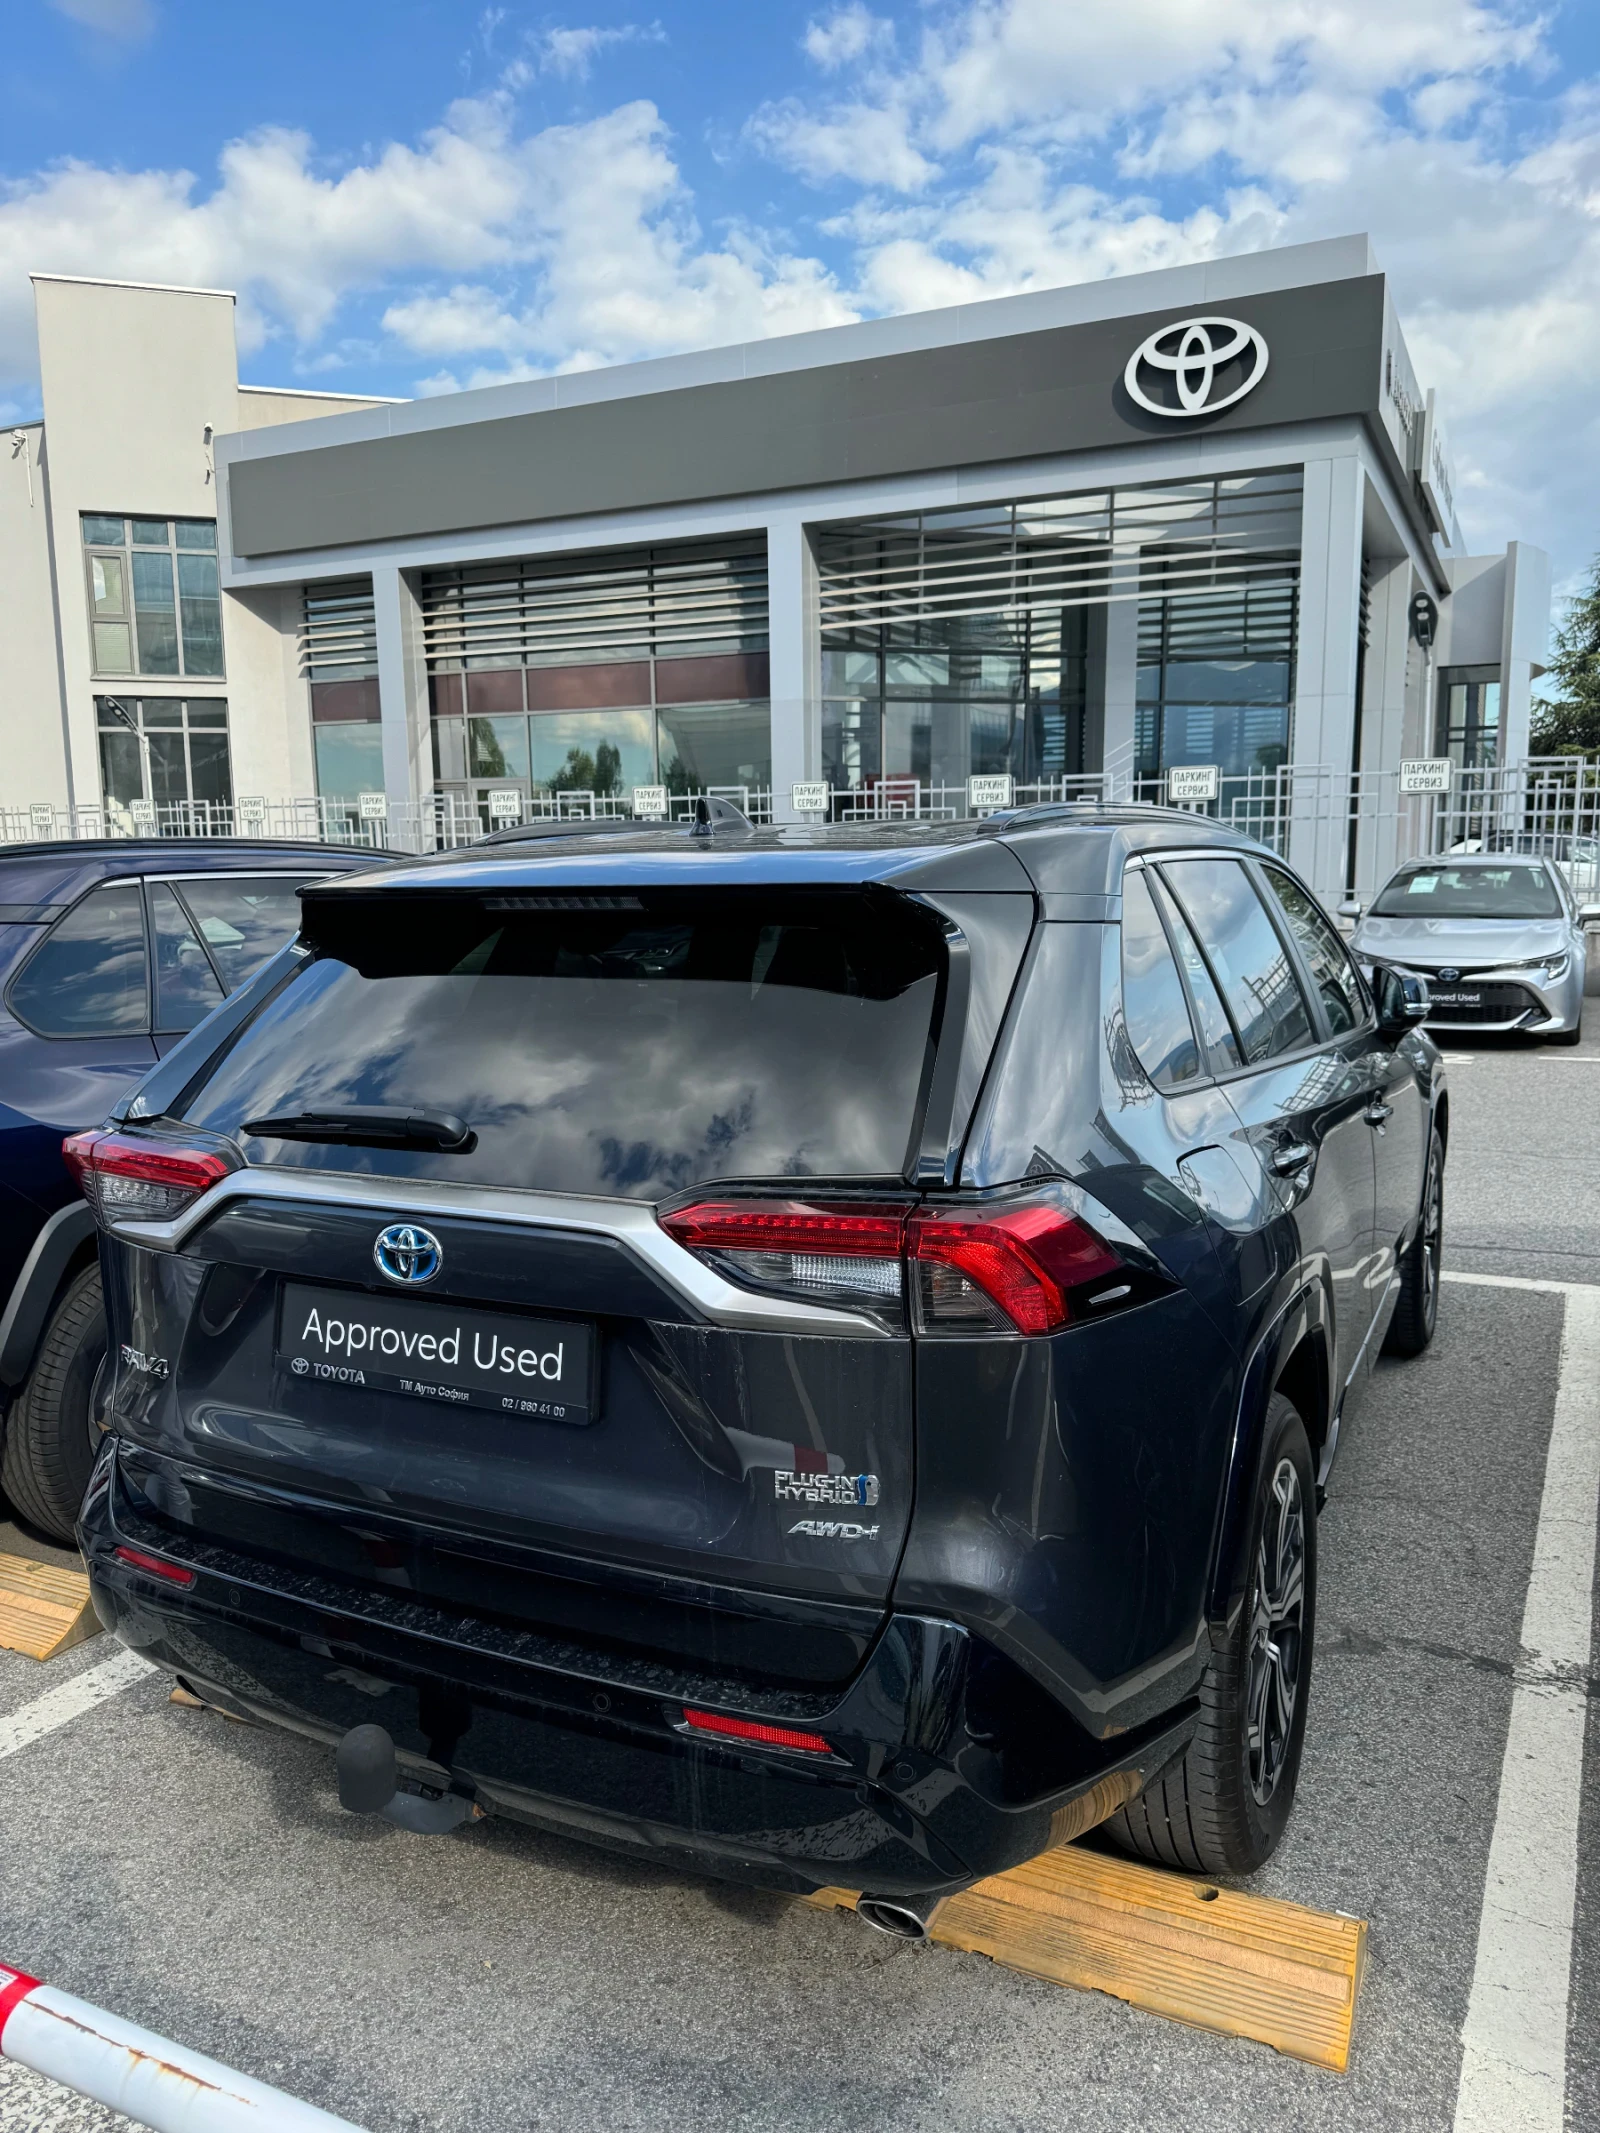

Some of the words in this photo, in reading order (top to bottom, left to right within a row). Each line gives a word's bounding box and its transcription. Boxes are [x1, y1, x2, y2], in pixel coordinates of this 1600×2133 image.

[1403, 762, 1448, 775] ПАРКИНГ
[1174, 770, 1213, 783] ПАРКИНГ
[973, 779, 1007, 790] ПАРКИНГ
[1407, 777, 1443, 789] СЕРВИЗ
[635, 789, 663, 799] ПАРКИНГ
[795, 785, 824, 796] ПАРКИНГ
[1177, 784, 1209, 796] СЕРВИЗ
[797, 798, 822, 808] СЕРВИЗ
[976, 792, 1004, 803] СЕРВИЗ
[638, 801, 662, 811] СЕРВИЗ
[1457, 993, 1480, 1001] Used
[301, 1308, 461, 1364] Approved
[474, 1332, 564, 1381] Used
[313, 1362, 365, 1384] TOYOTA
[400, 1379, 413, 1391] ТМ
[414, 1382, 436, 1396] Ауто
[438, 1386, 470, 1401] София
[501, 1397, 514, 1409] 02
[539, 1403, 551, 1415] 41
[553, 1406, 566, 1417] 00
[774, 1470, 859, 1490] PLUG-IN
[774, 1485, 858, 1505] HYBRID
